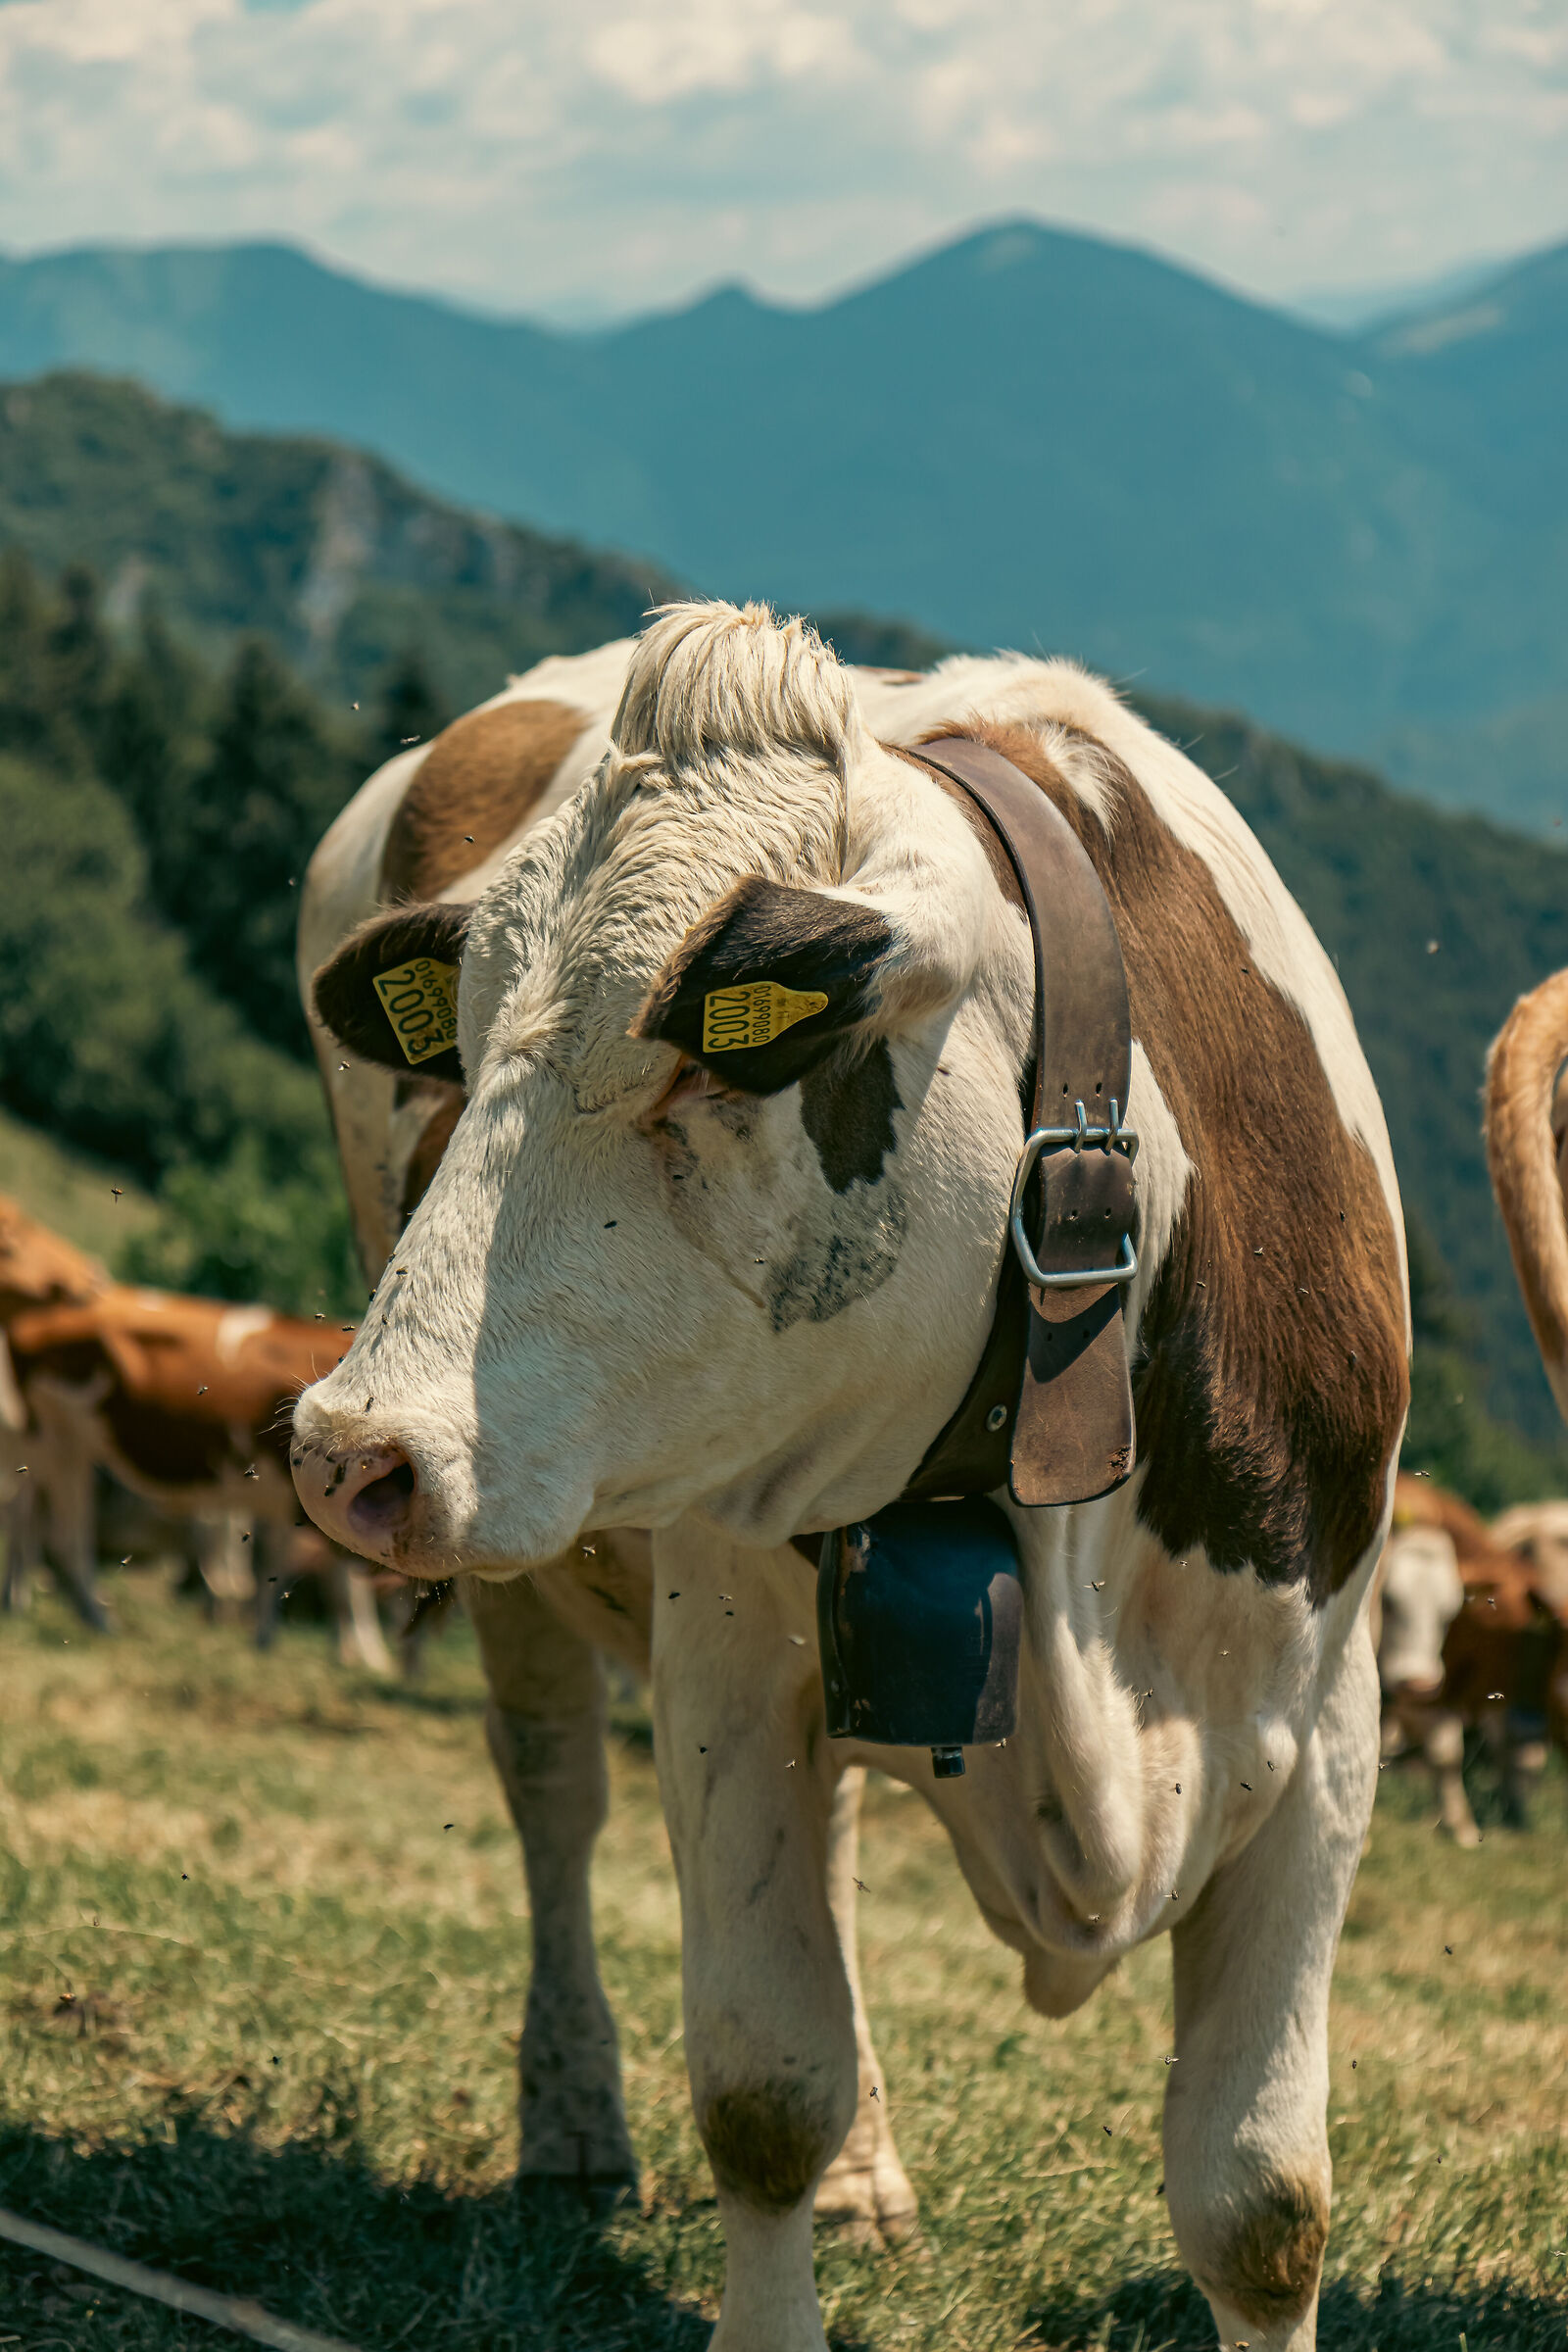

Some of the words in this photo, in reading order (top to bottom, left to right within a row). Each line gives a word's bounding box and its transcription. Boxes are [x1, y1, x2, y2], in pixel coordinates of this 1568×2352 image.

[378, 969, 445, 1054] 2003
[708, 991, 751, 1049] 2003
[752, 985, 771, 1043] 01699080
